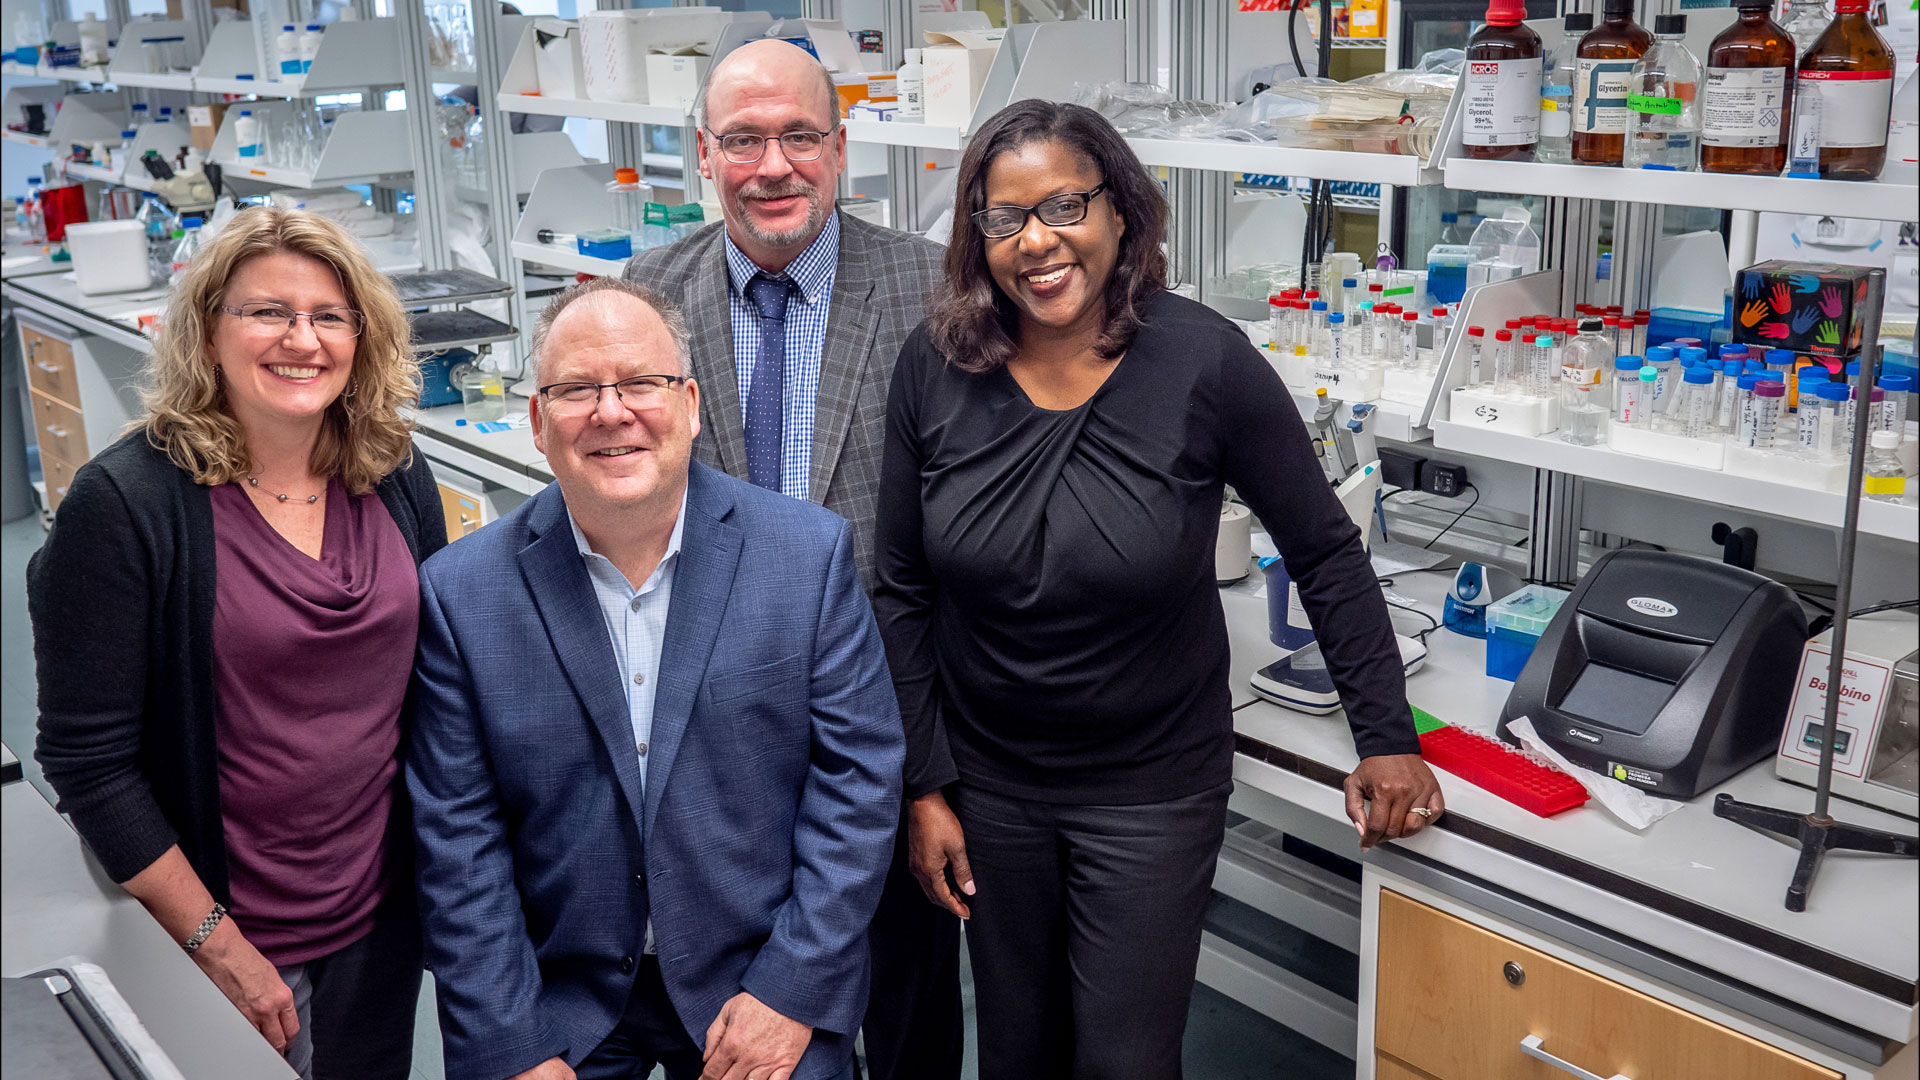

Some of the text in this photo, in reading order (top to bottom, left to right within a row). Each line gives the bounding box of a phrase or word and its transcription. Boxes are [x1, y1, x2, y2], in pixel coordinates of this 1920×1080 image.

[1472, 64, 1498, 74] ACROS
[1599, 85, 1628, 94] Glycerin
[1469, 108, 1494, 116] Glycerol,
[1810, 344, 1835, 353] Thermo
[1631, 599, 1675, 614] GLOMAX
[1808, 677, 1871, 702] Babino
[1576, 732, 1599, 742] Promega
